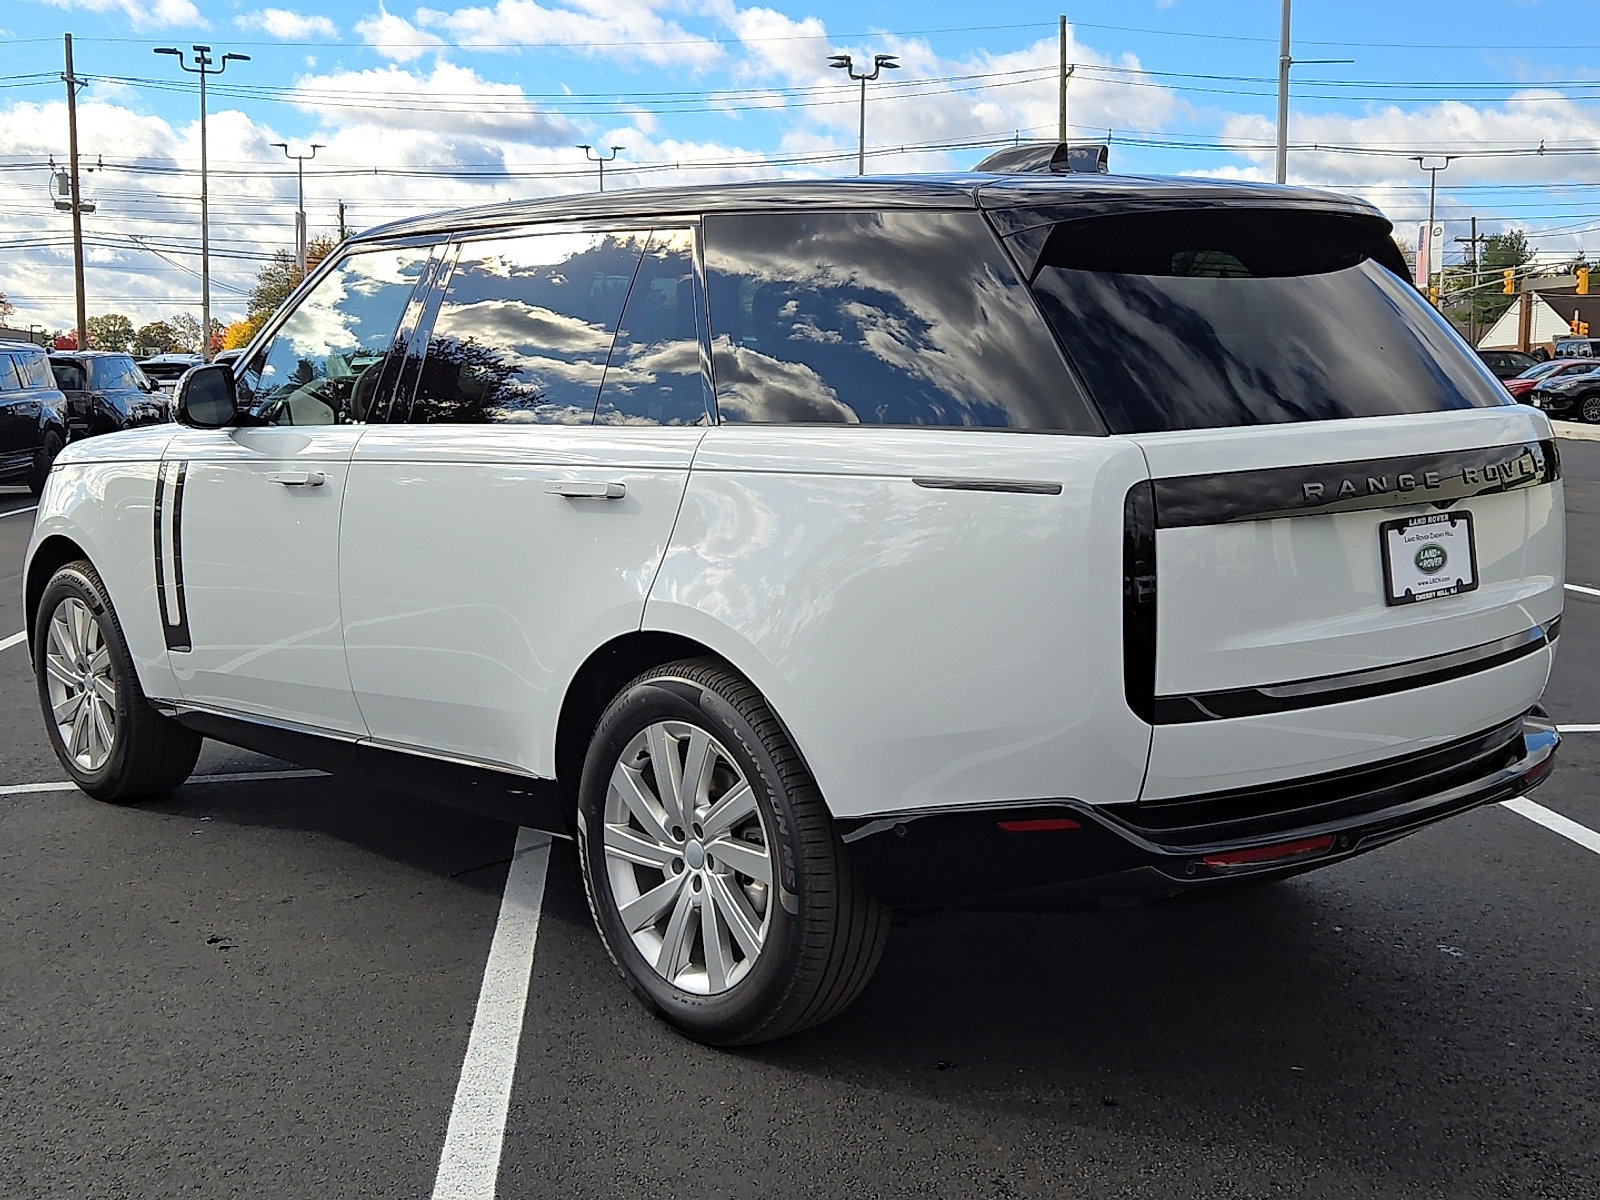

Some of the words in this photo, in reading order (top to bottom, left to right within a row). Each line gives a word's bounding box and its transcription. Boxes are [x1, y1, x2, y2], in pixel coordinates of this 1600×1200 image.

[1302, 471, 1441, 500] RANGE
[1462, 458, 1546, 486] ROVER
[1409, 517, 1427, 526] LAND
[1427, 514, 1449, 524] ROVER
[1420, 549, 1437, 560] LAND
[1423, 557, 1443, 568] ROVER
[1415, 591, 1436, 601] CHERRY
